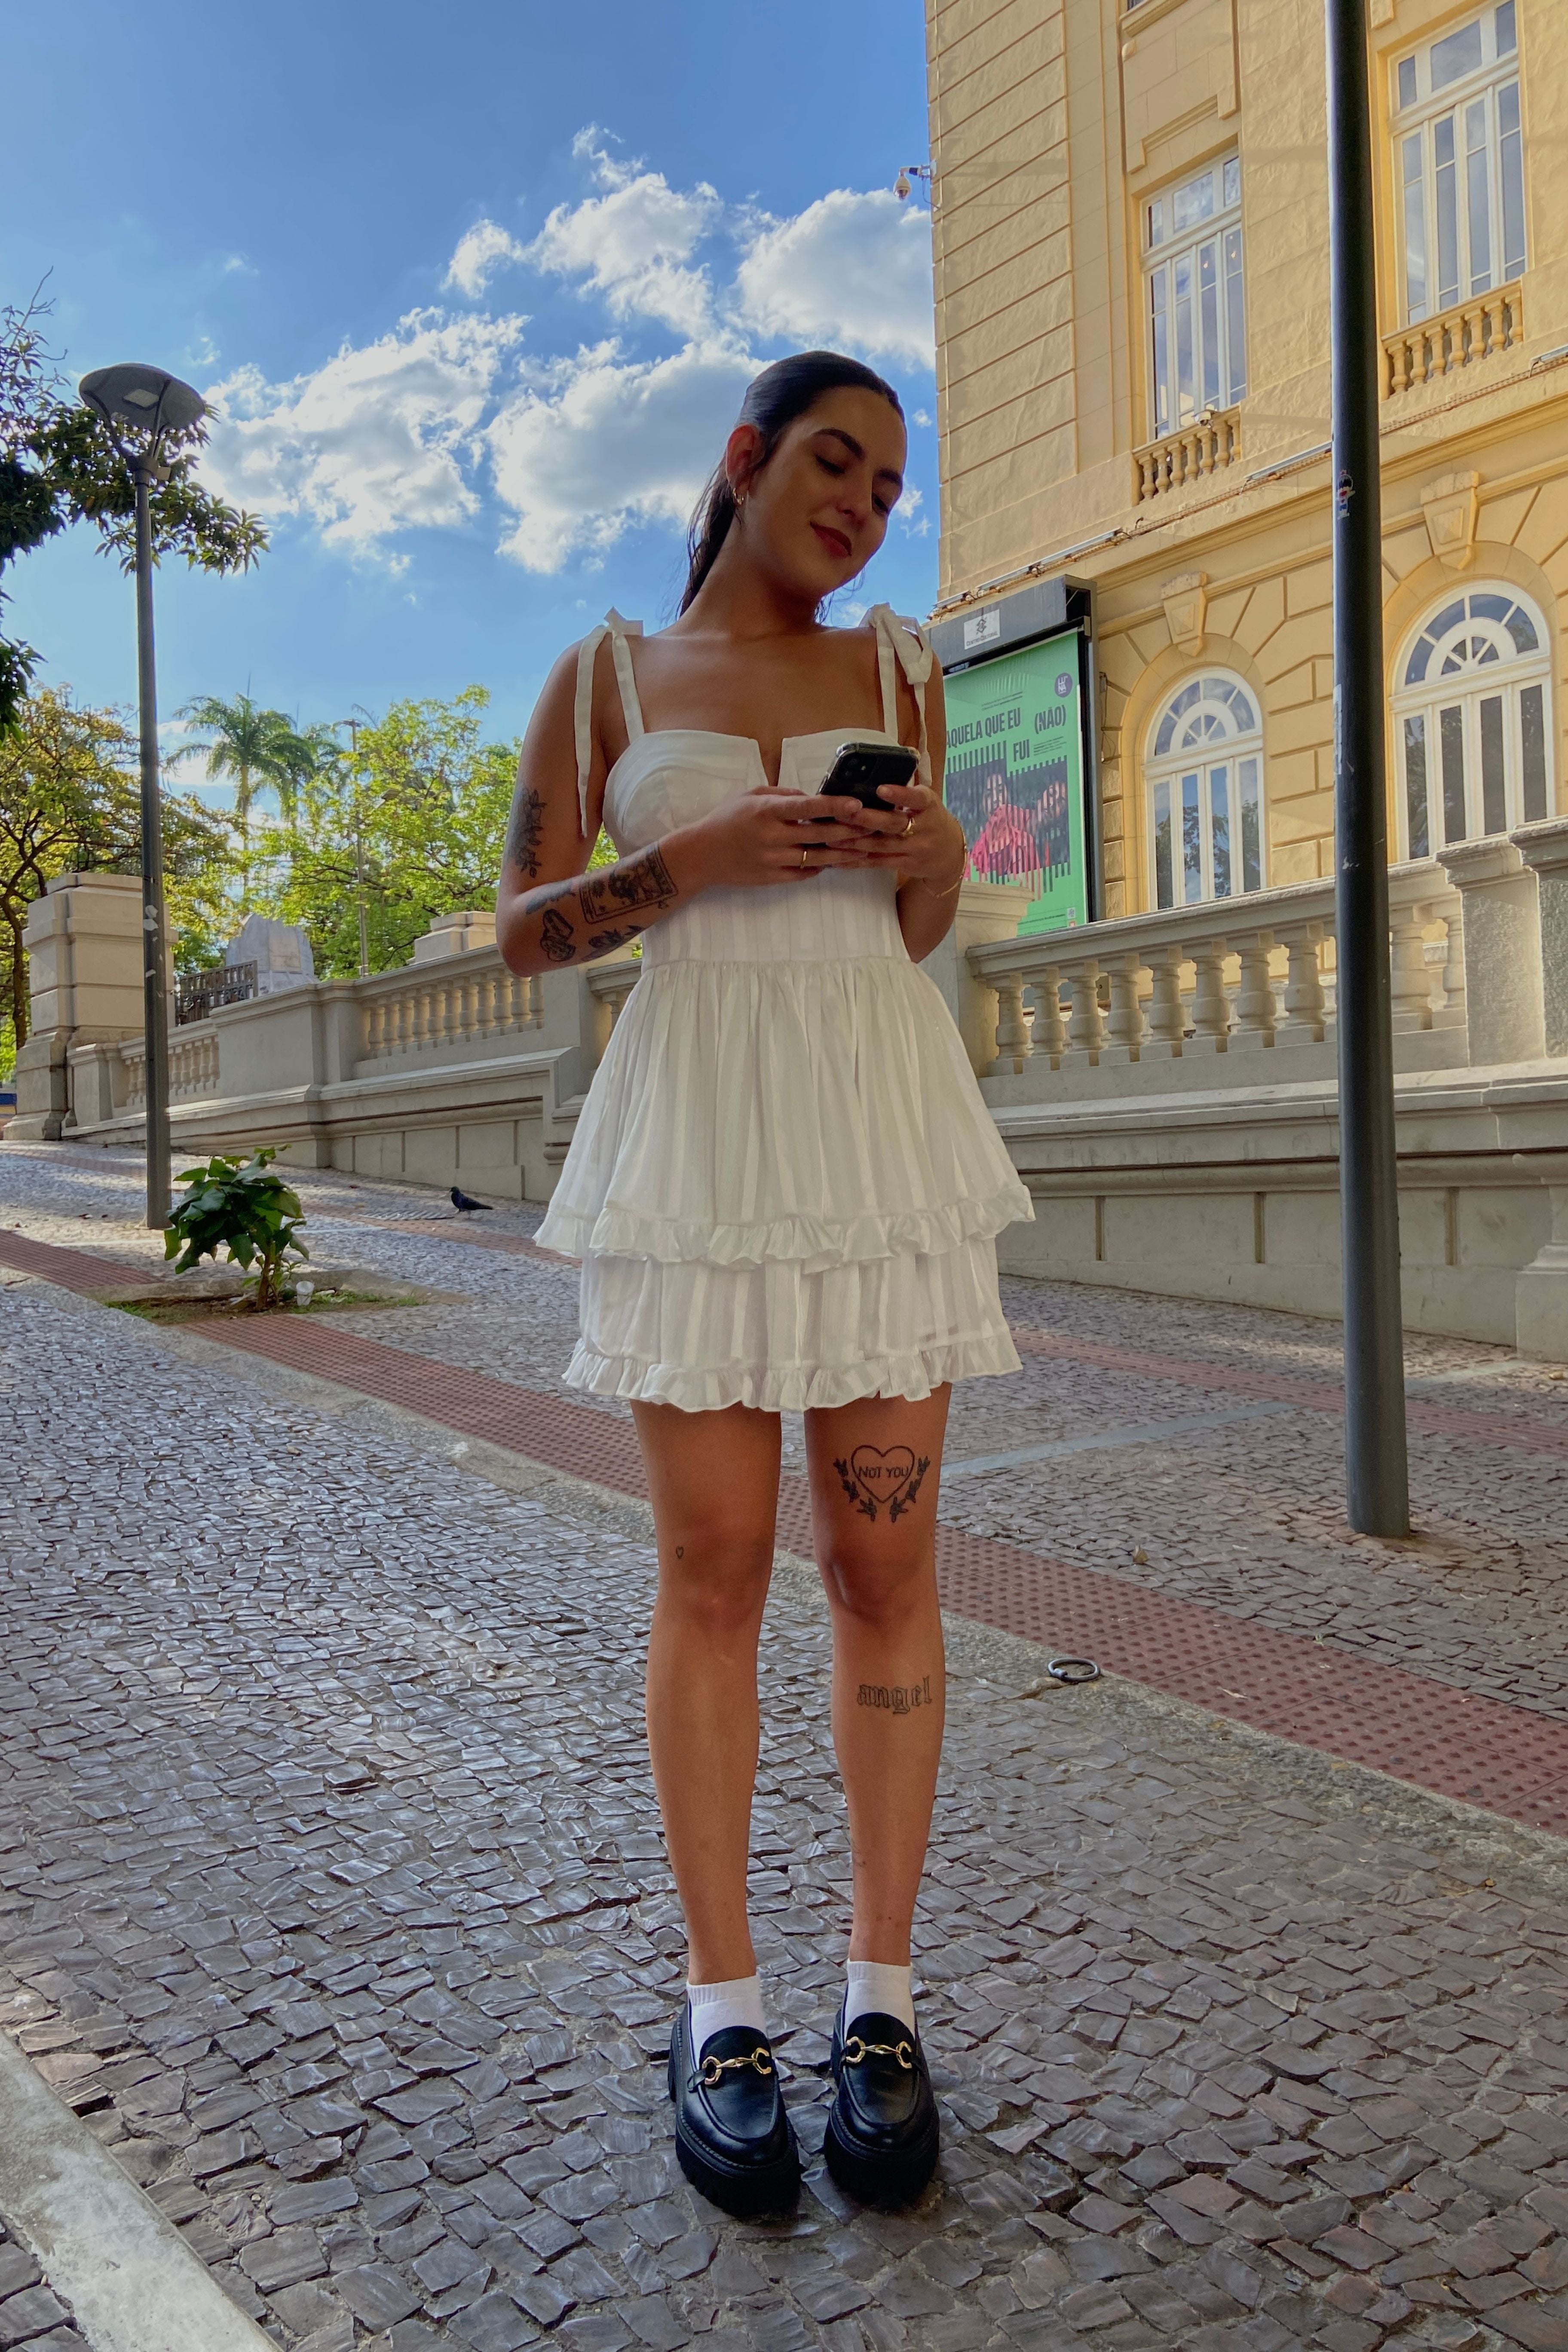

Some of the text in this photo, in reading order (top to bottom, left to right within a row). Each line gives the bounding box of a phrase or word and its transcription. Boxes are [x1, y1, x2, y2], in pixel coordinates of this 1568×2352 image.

[946, 704, 1066, 748] AQUELA QUE EU (NÃO)
[1013, 739, 1030, 762] FUI
[859, 1466, 910, 1479] NOT YOU
[857, 1675, 932, 1715] angel
